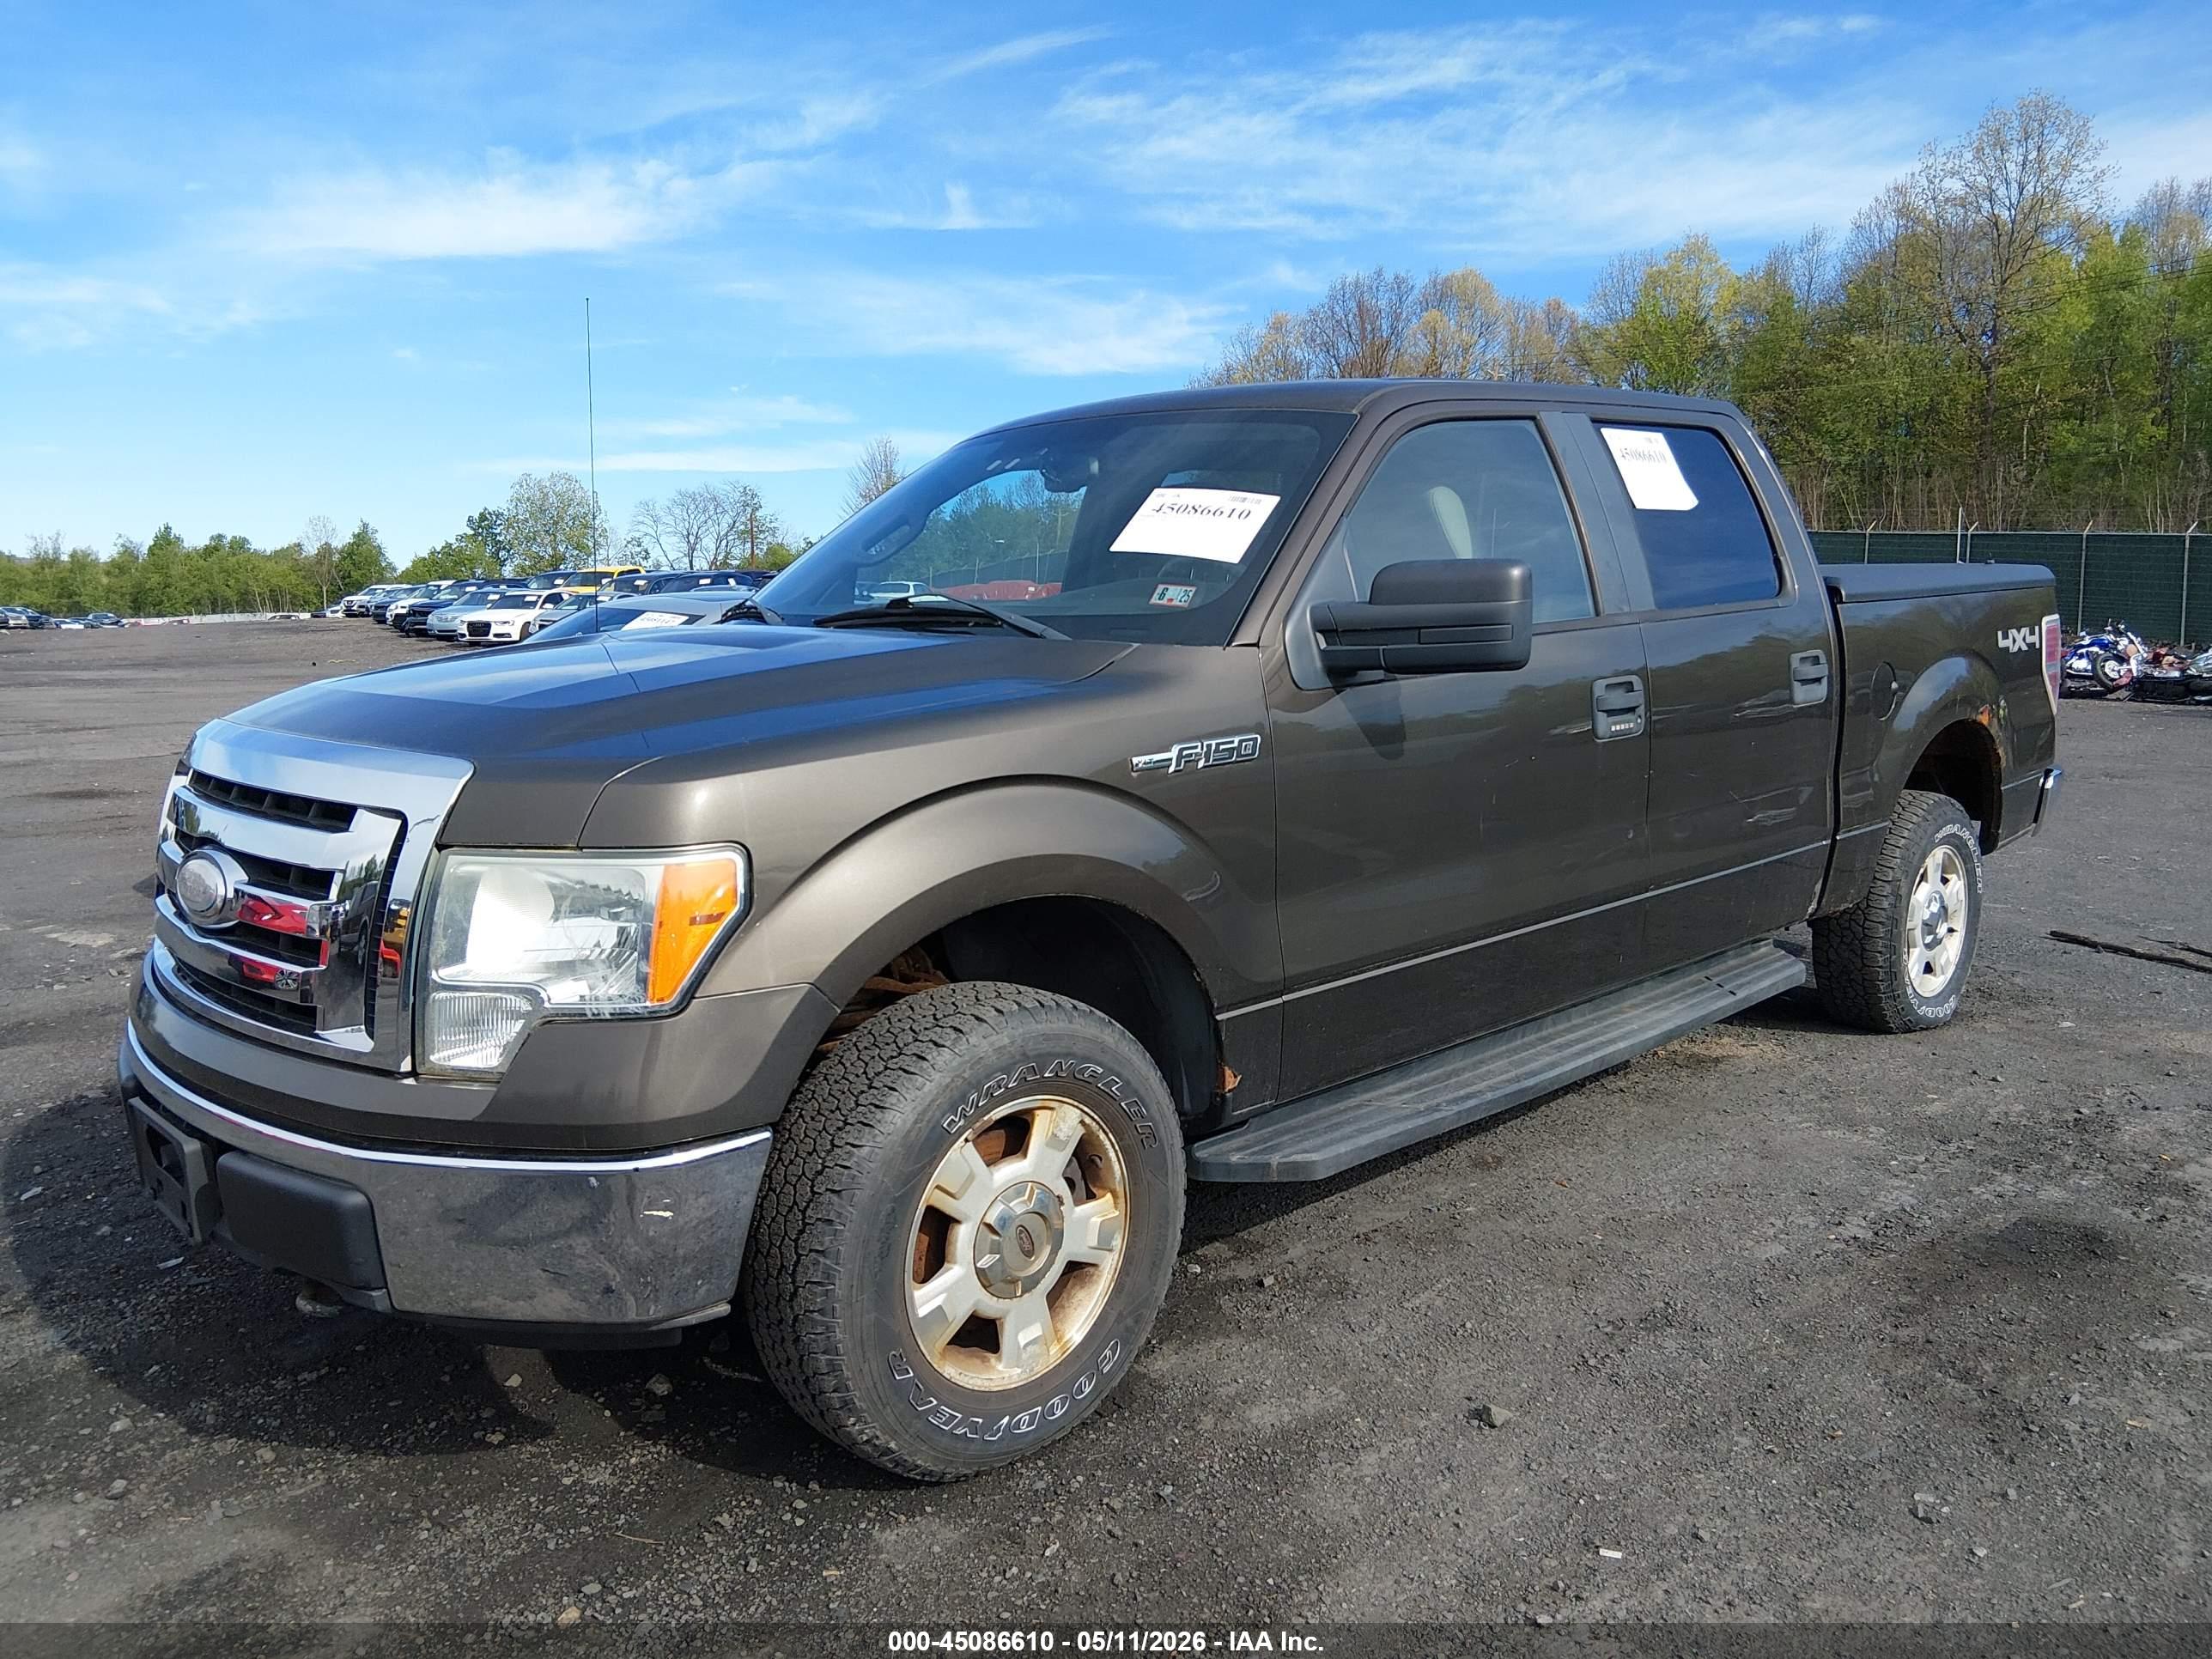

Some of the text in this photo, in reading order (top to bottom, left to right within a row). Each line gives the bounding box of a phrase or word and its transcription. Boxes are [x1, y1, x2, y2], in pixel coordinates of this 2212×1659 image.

[1152, 502, 1251, 520] 45086610
[1179, 589, 1193, 603] 25
[941, 1059, 1159, 1151] WRANGLER
[888, 1339, 1121, 1441] GOODYEAR
